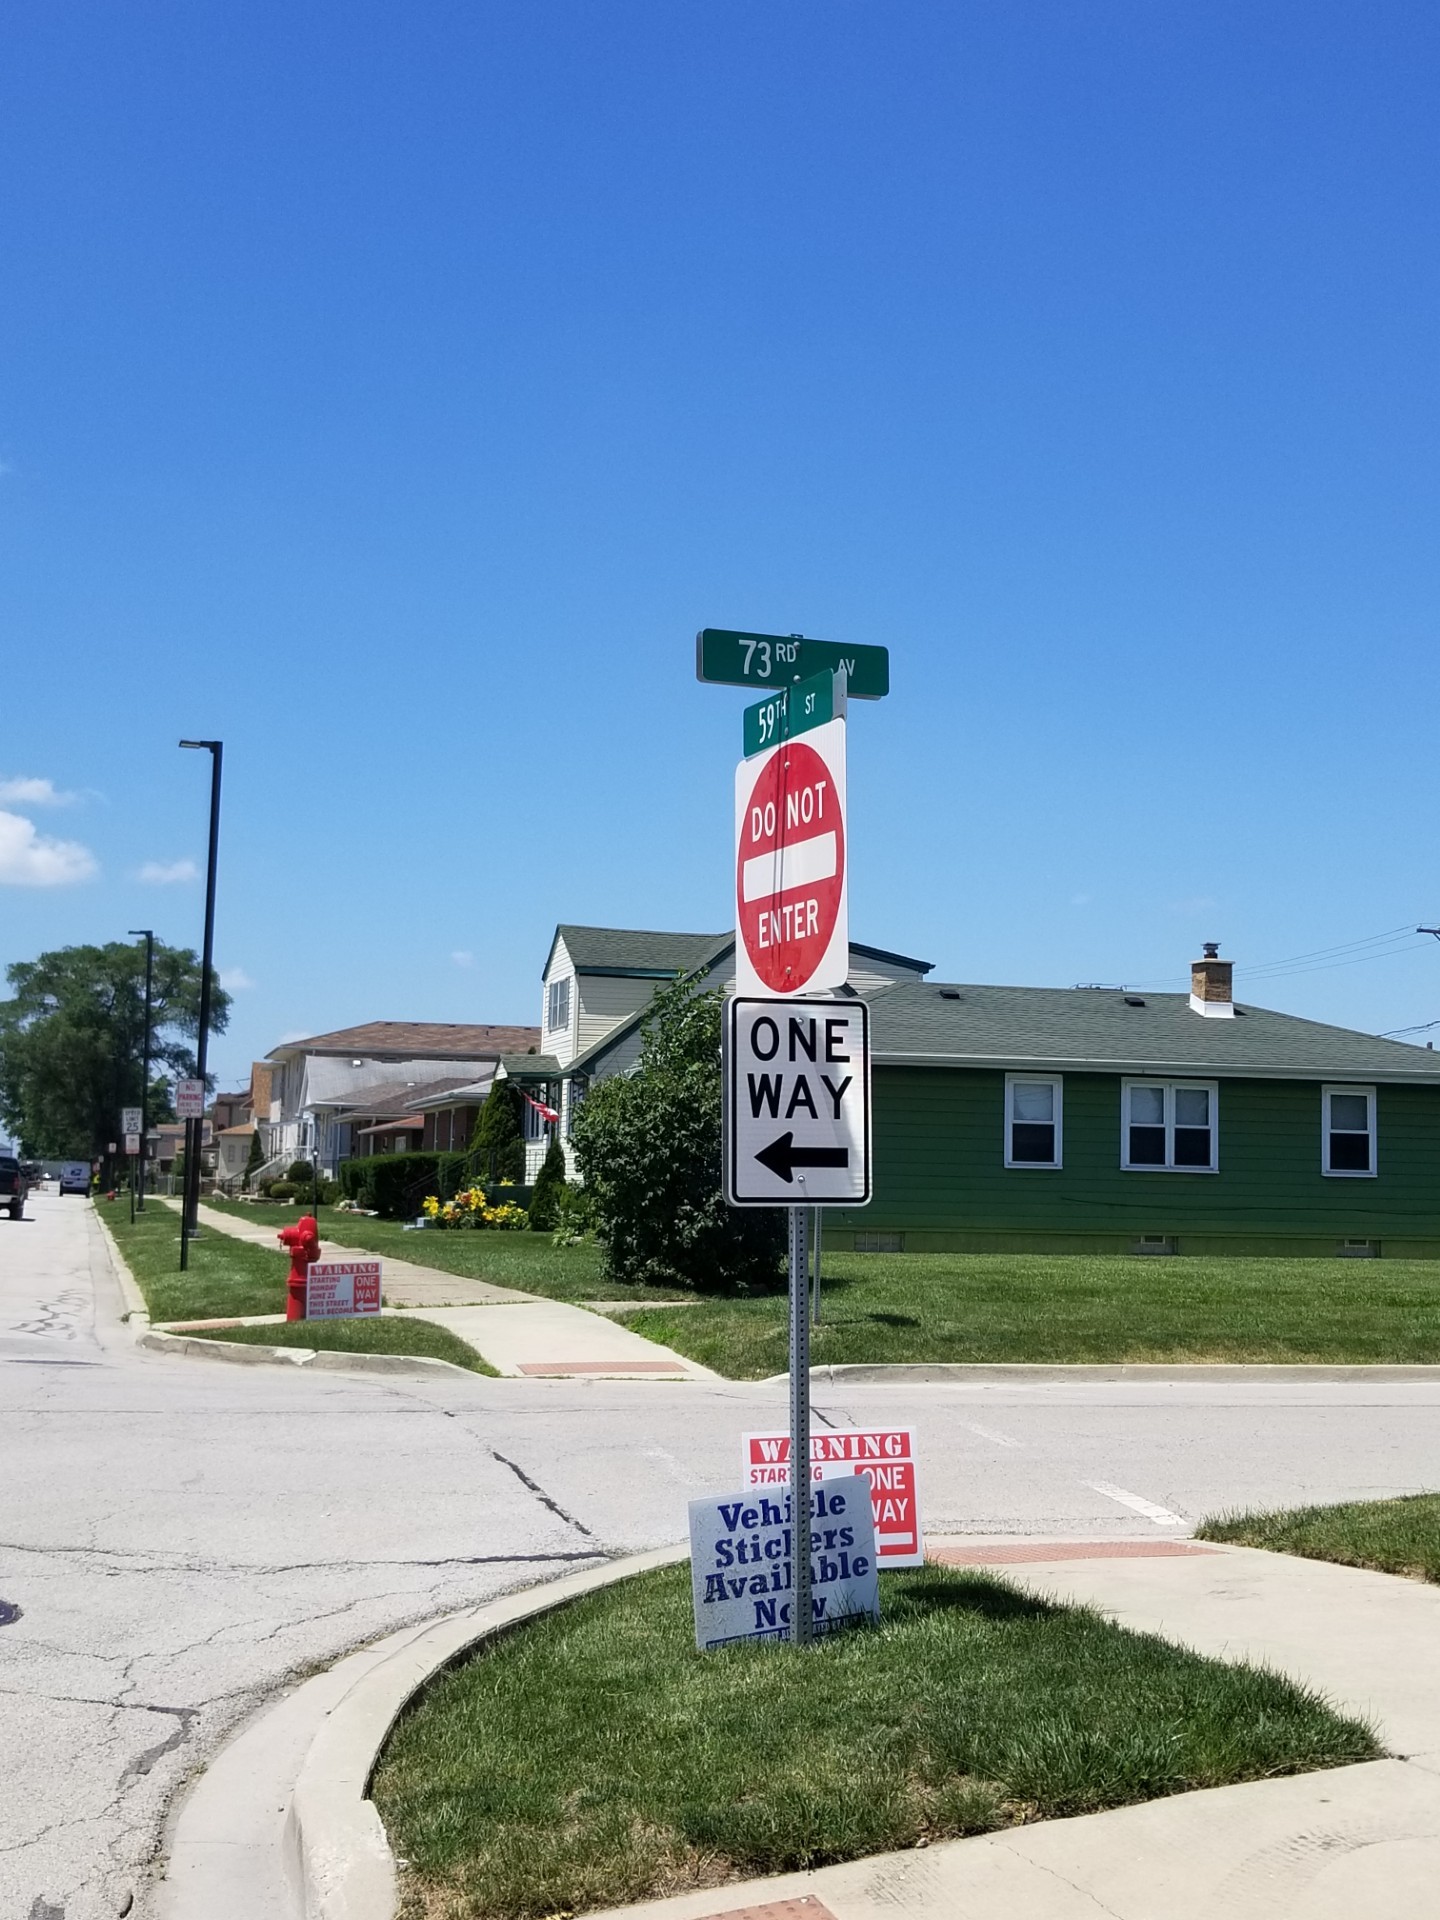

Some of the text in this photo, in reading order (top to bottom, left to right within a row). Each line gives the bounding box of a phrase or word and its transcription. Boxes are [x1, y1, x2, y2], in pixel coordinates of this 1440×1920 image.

[738, 639, 855, 678] 73RD AV
[759, 693, 816, 744] 59TH ST
[752, 781, 827, 843] DO NOT
[758, 898, 819, 949] ENTER
[750, 1016, 850, 1062] ONE
[747, 1073, 853, 1120] WAY
[126, 1122, 139, 1132] 25
[314, 1263, 376, 1275] WARNING
[310, 1276, 341, 1284] STARTING
[356, 1276, 376, 1287] ONE
[310, 1284, 337, 1292] MONDAY
[356, 1289, 377, 1299] WAY
[309, 1292, 326, 1300] JUNE
[326, 1299, 349, 1307] STREET
[309, 1307, 353, 1316] WILL BECOME
[759, 1434, 902, 1462] WRNING
[750, 1466, 823, 1484] STARG
[862, 1466, 906, 1491] ONE
